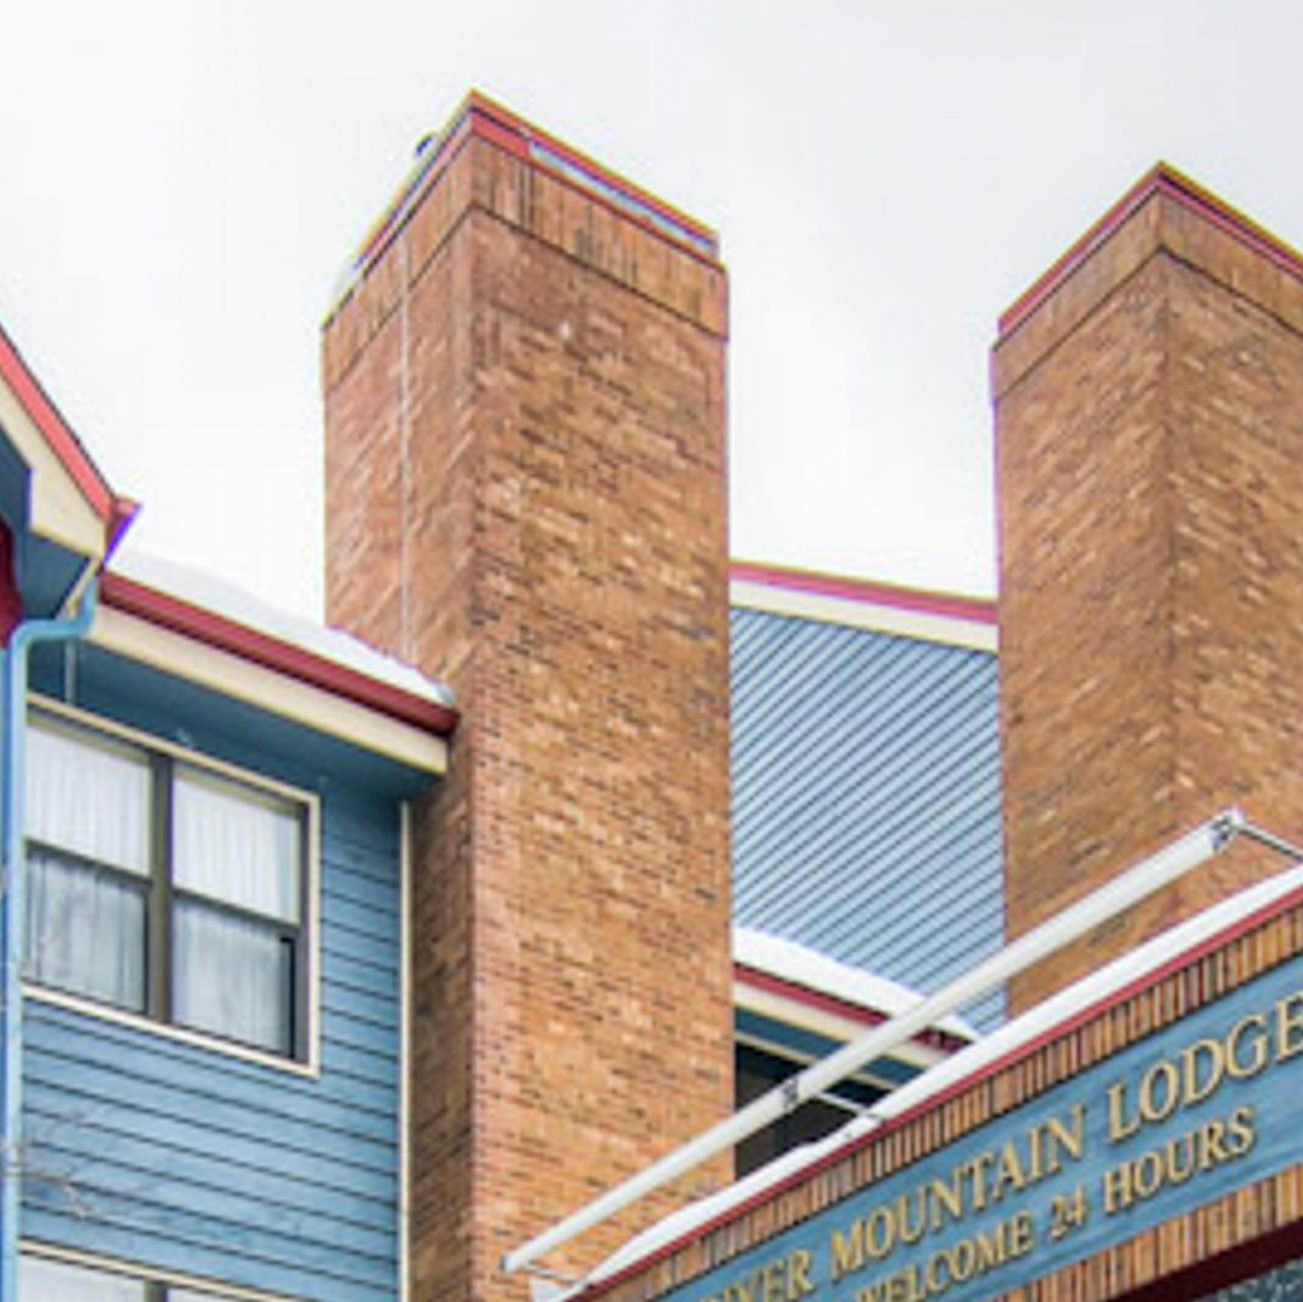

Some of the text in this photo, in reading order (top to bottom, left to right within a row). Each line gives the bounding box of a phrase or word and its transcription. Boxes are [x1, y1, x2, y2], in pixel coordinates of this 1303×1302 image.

[828, 1104, 1086, 1282] MOUNTAIN
[1049, 1184, 1087, 1240] 24
[1103, 1105, 1255, 1214] HOURS
